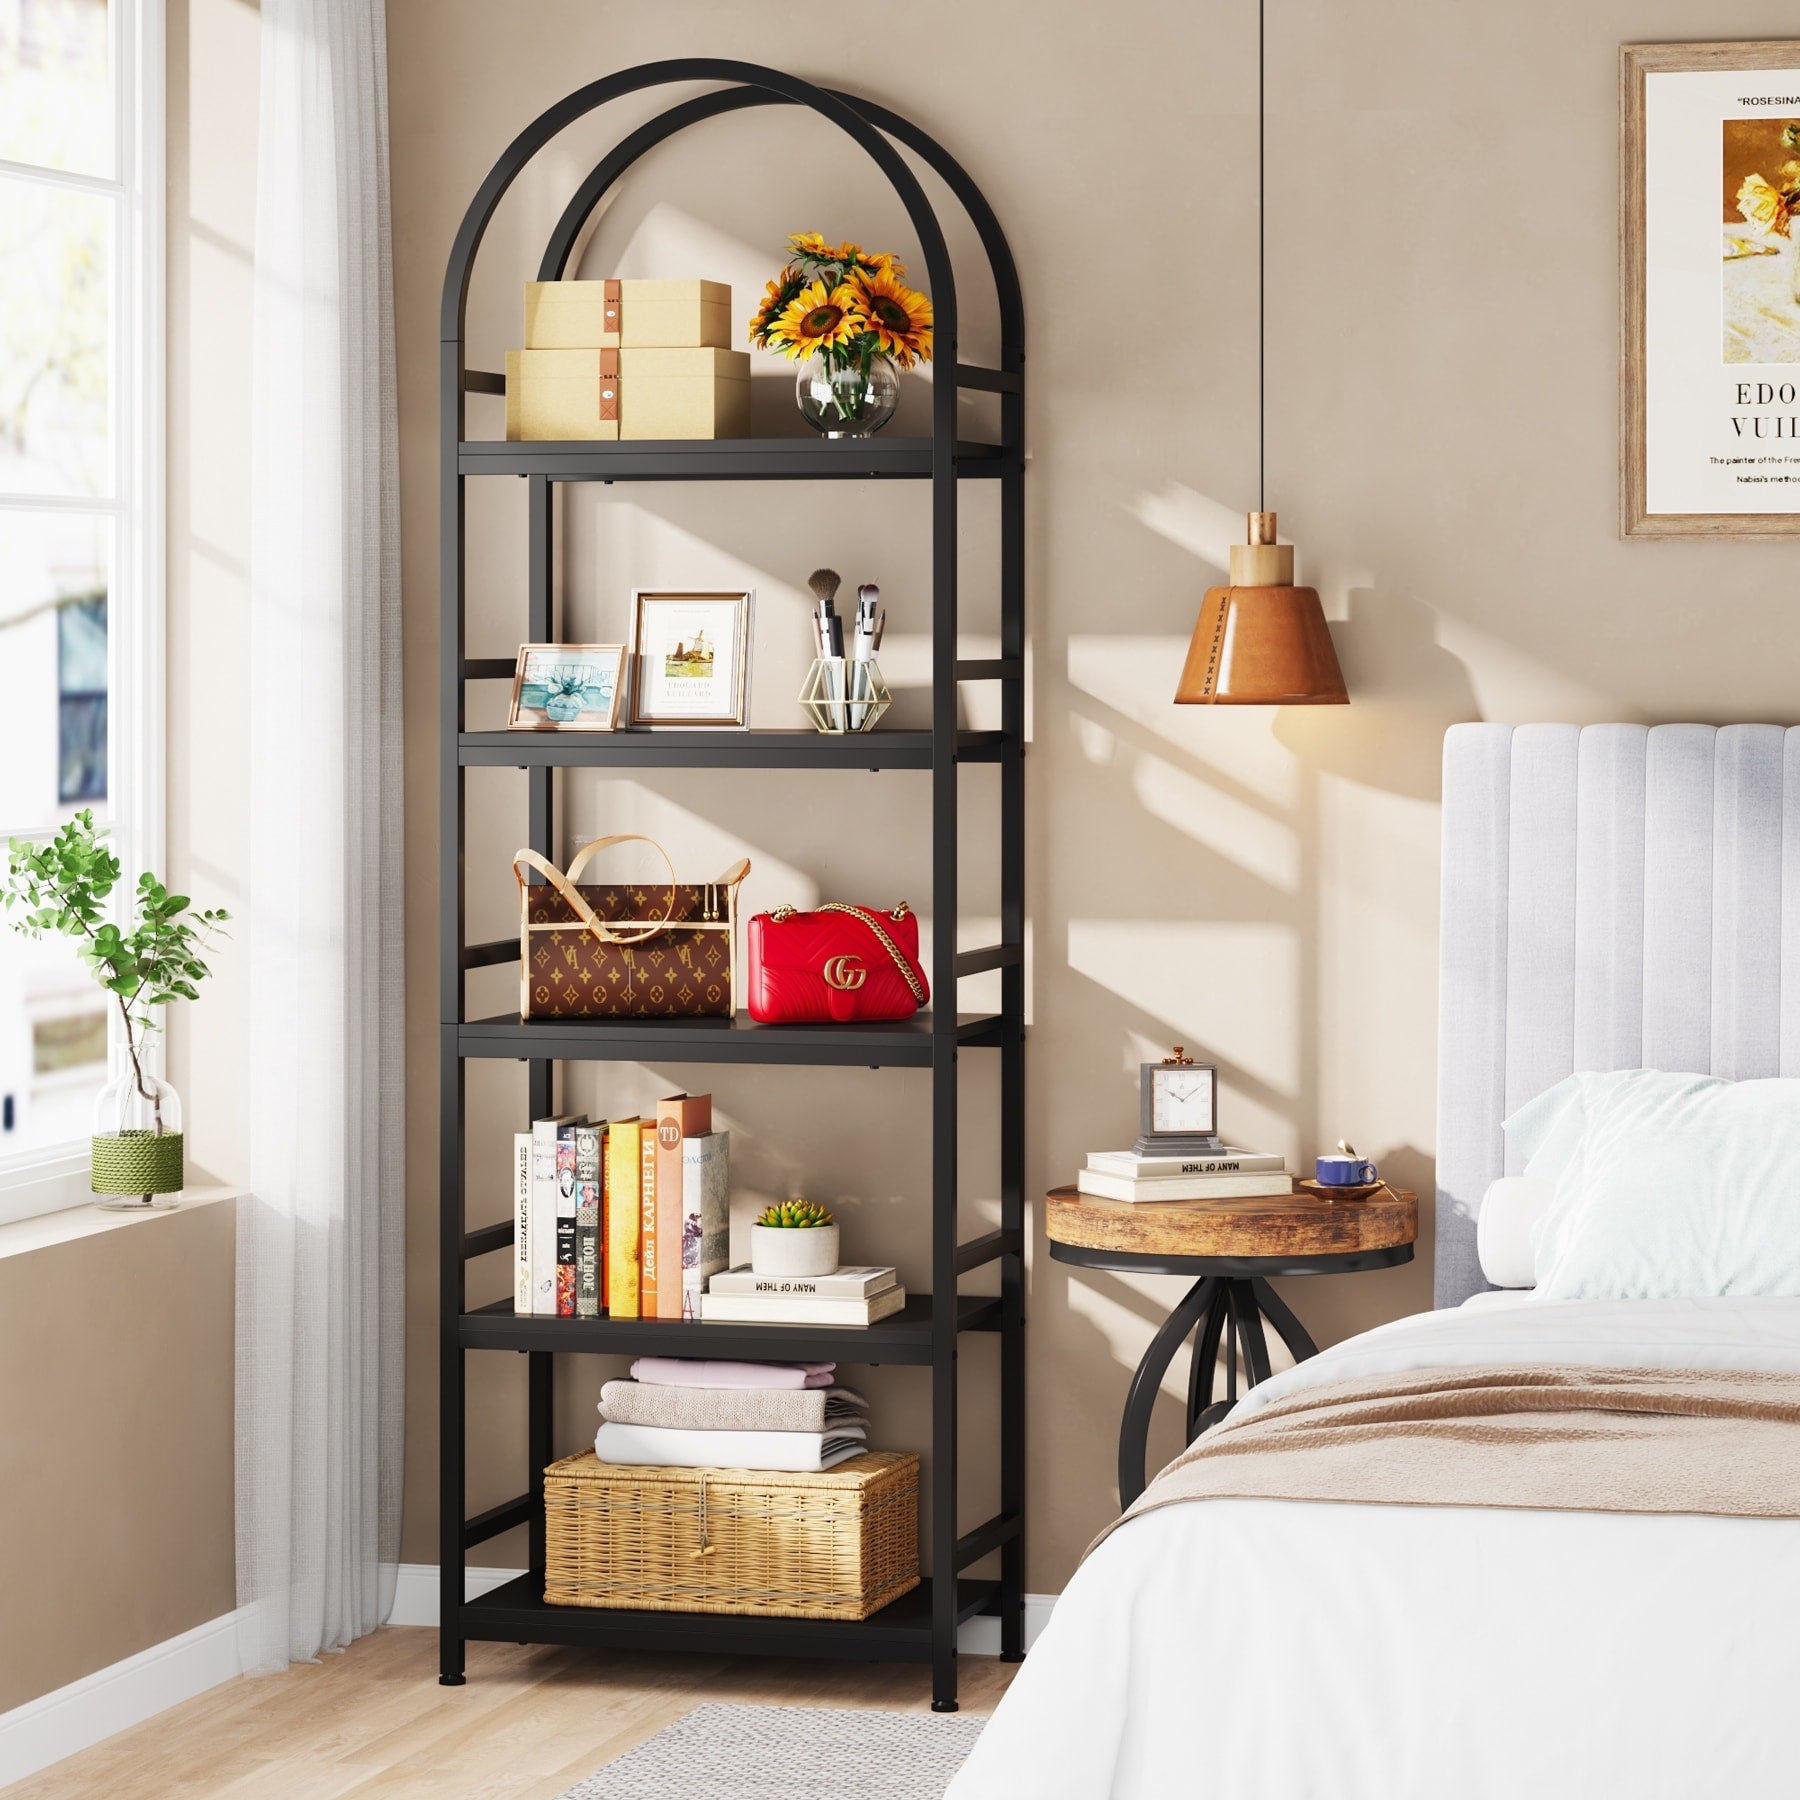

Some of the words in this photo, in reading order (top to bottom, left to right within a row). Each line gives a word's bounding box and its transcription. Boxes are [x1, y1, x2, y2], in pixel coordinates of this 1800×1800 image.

[1735, 383, 1796, 405] EDO
[1730, 416, 1800, 438] VUIL
[1710, 456, 1725, 464] The
[1726, 457, 1756, 466] painter
[1757, 456, 1767, 464] of
[1768, 456, 1782, 464] the
[660, 1126, 680, 1142] TD
[1182, 1163, 1203, 1173] THEM
[1205, 1162, 1216, 1172] OF
[1217, 1161, 1240, 1171] MANY
[642, 1140, 654, 1232] КАРНЕГИ
[643, 1239, 656, 1280] Дейл
[755, 1281, 778, 1292] THEM
[780, 1282, 791, 1292] OF
[793, 1282, 816, 1293] MANY
